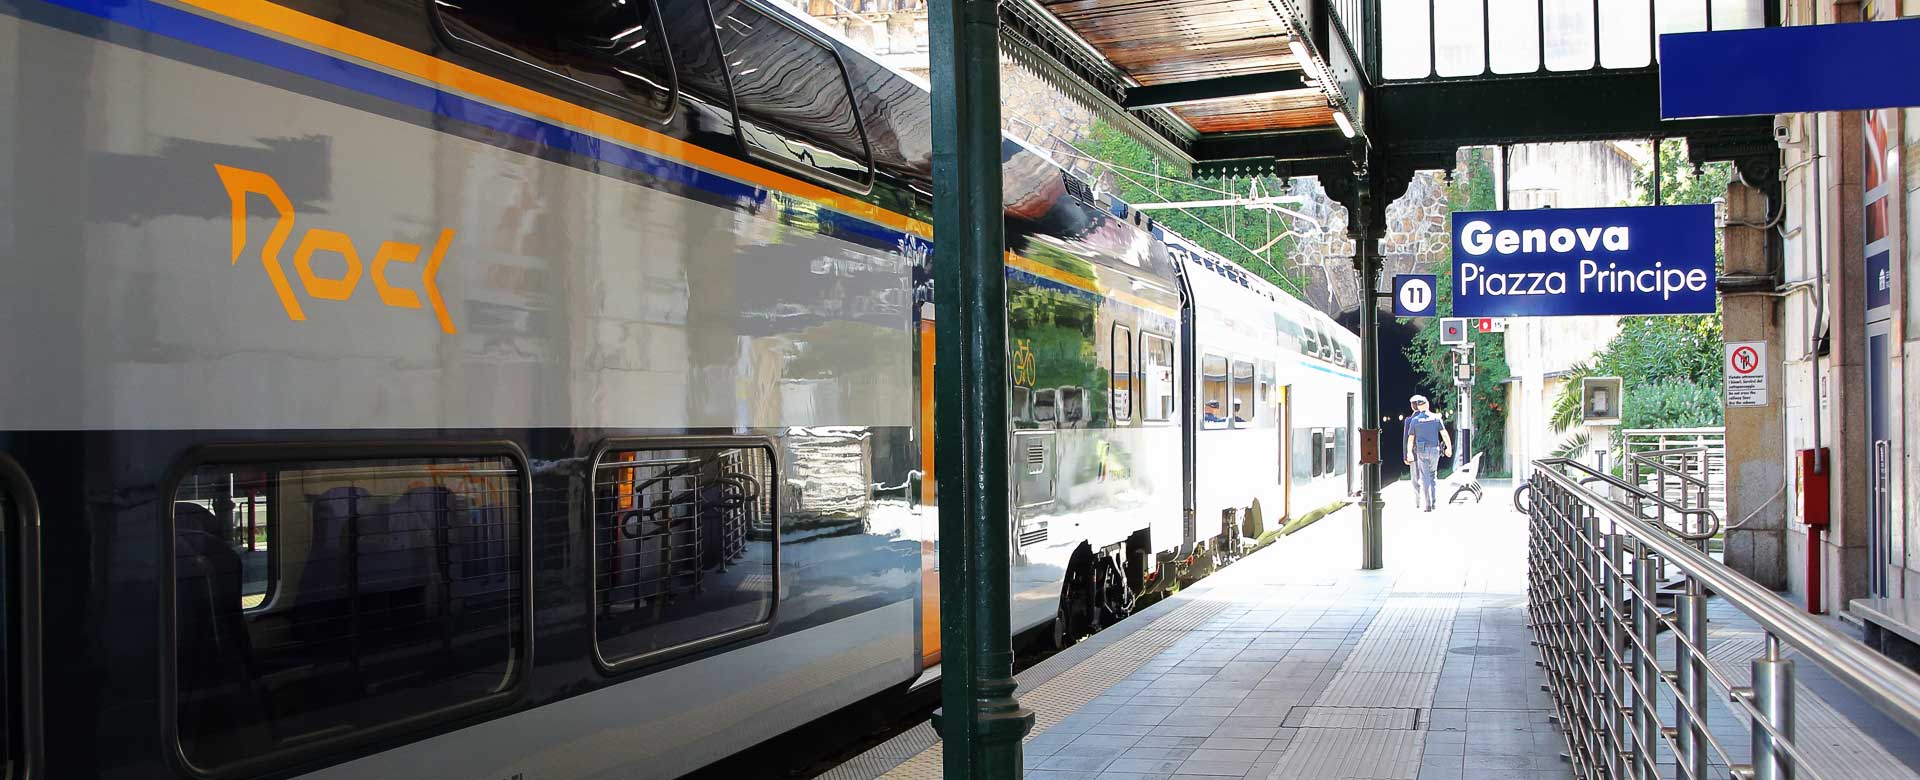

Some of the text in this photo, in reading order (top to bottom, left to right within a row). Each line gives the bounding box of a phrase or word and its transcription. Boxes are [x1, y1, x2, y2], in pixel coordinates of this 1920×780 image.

[215, 164, 456, 334] Rock
[1460, 220, 1630, 256] Genova
[1408, 286, 1424, 304] 11
[1461, 259, 1707, 301] Piazza Principe
